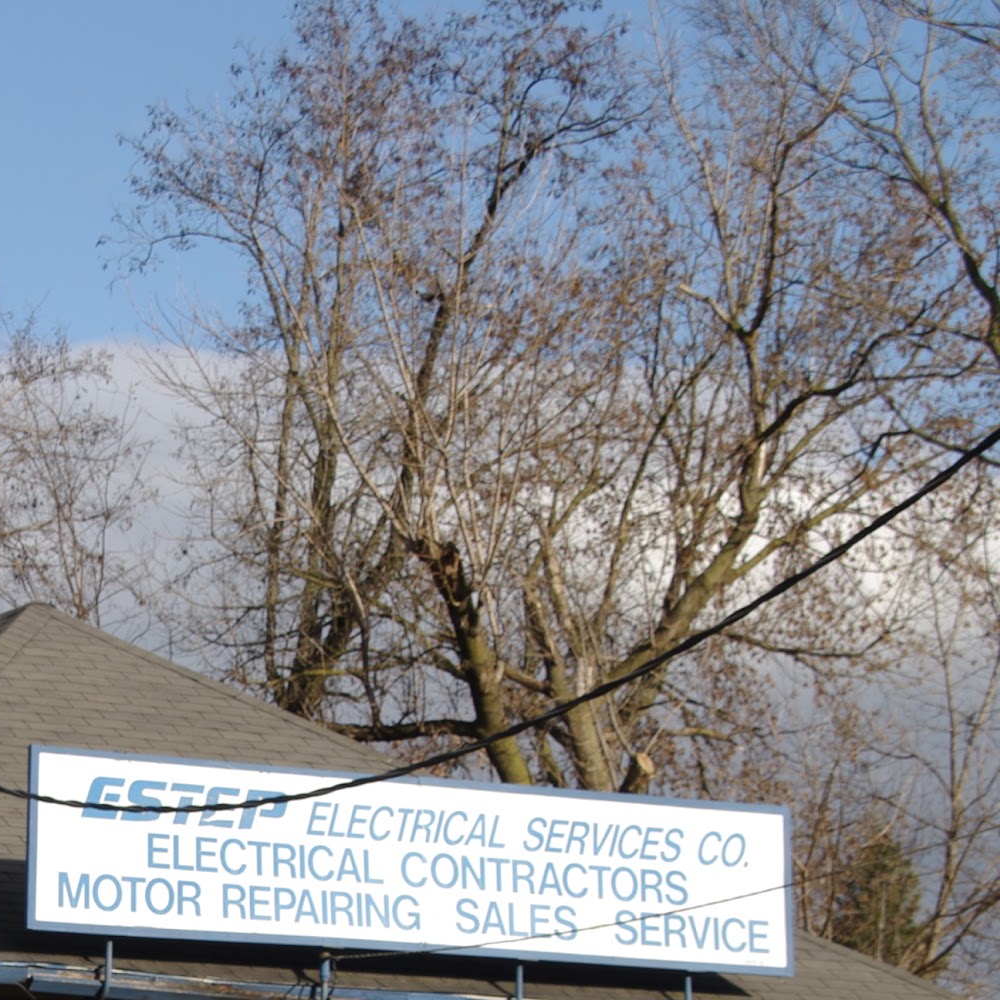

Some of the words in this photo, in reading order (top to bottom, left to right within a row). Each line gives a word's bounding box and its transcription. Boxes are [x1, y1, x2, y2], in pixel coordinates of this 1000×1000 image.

[81, 776, 288, 829] ESTEP
[306, 801, 505, 849] ELECTRICAL
[523, 816, 684, 863] SERVICES
[698, 831, 749, 868] CO.
[147, 832, 384, 885] ELECTRICAL
[400, 851, 688, 906] CONTRACTORS
[58, 871, 201, 917] MOTOR
[222, 883, 421, 931] REPAIRING
[455, 898, 578, 941] SALES
[614, 910, 770, 954] SERVICE
